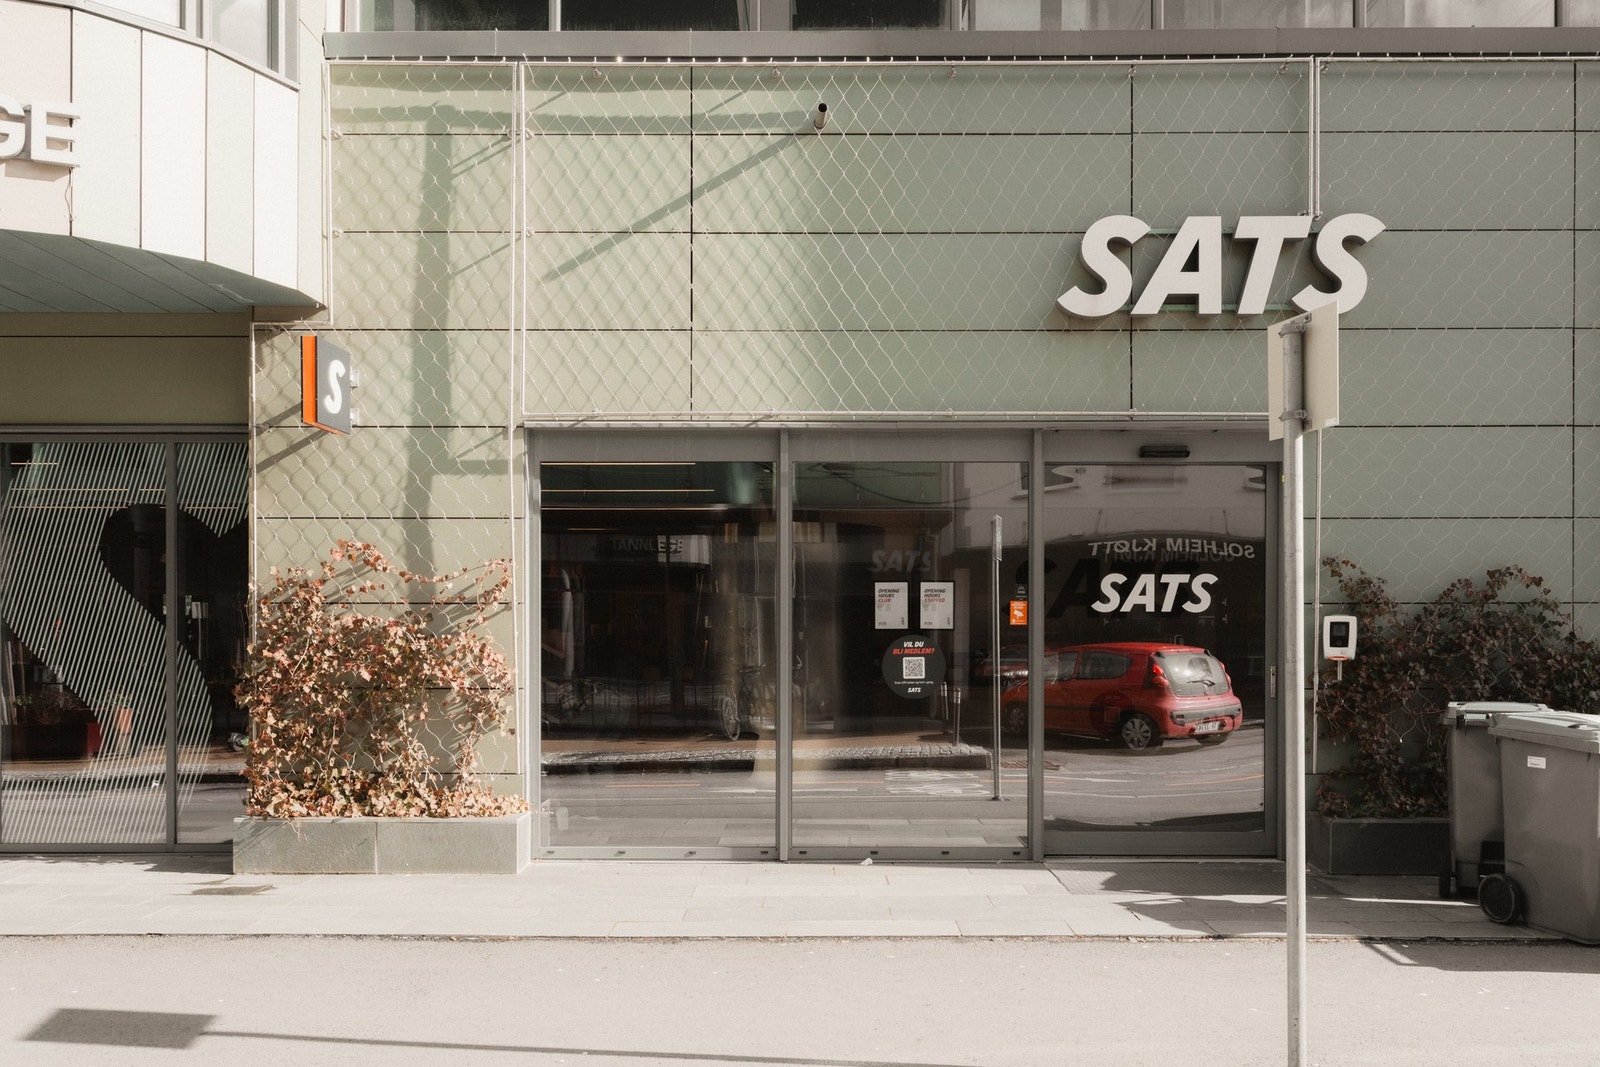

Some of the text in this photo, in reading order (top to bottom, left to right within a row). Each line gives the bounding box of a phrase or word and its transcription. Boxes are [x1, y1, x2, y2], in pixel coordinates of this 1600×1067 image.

[1056, 213, 1387, 317] SATS
[324, 360, 346, 414] S
[1091, 573, 1219, 613] SATS
